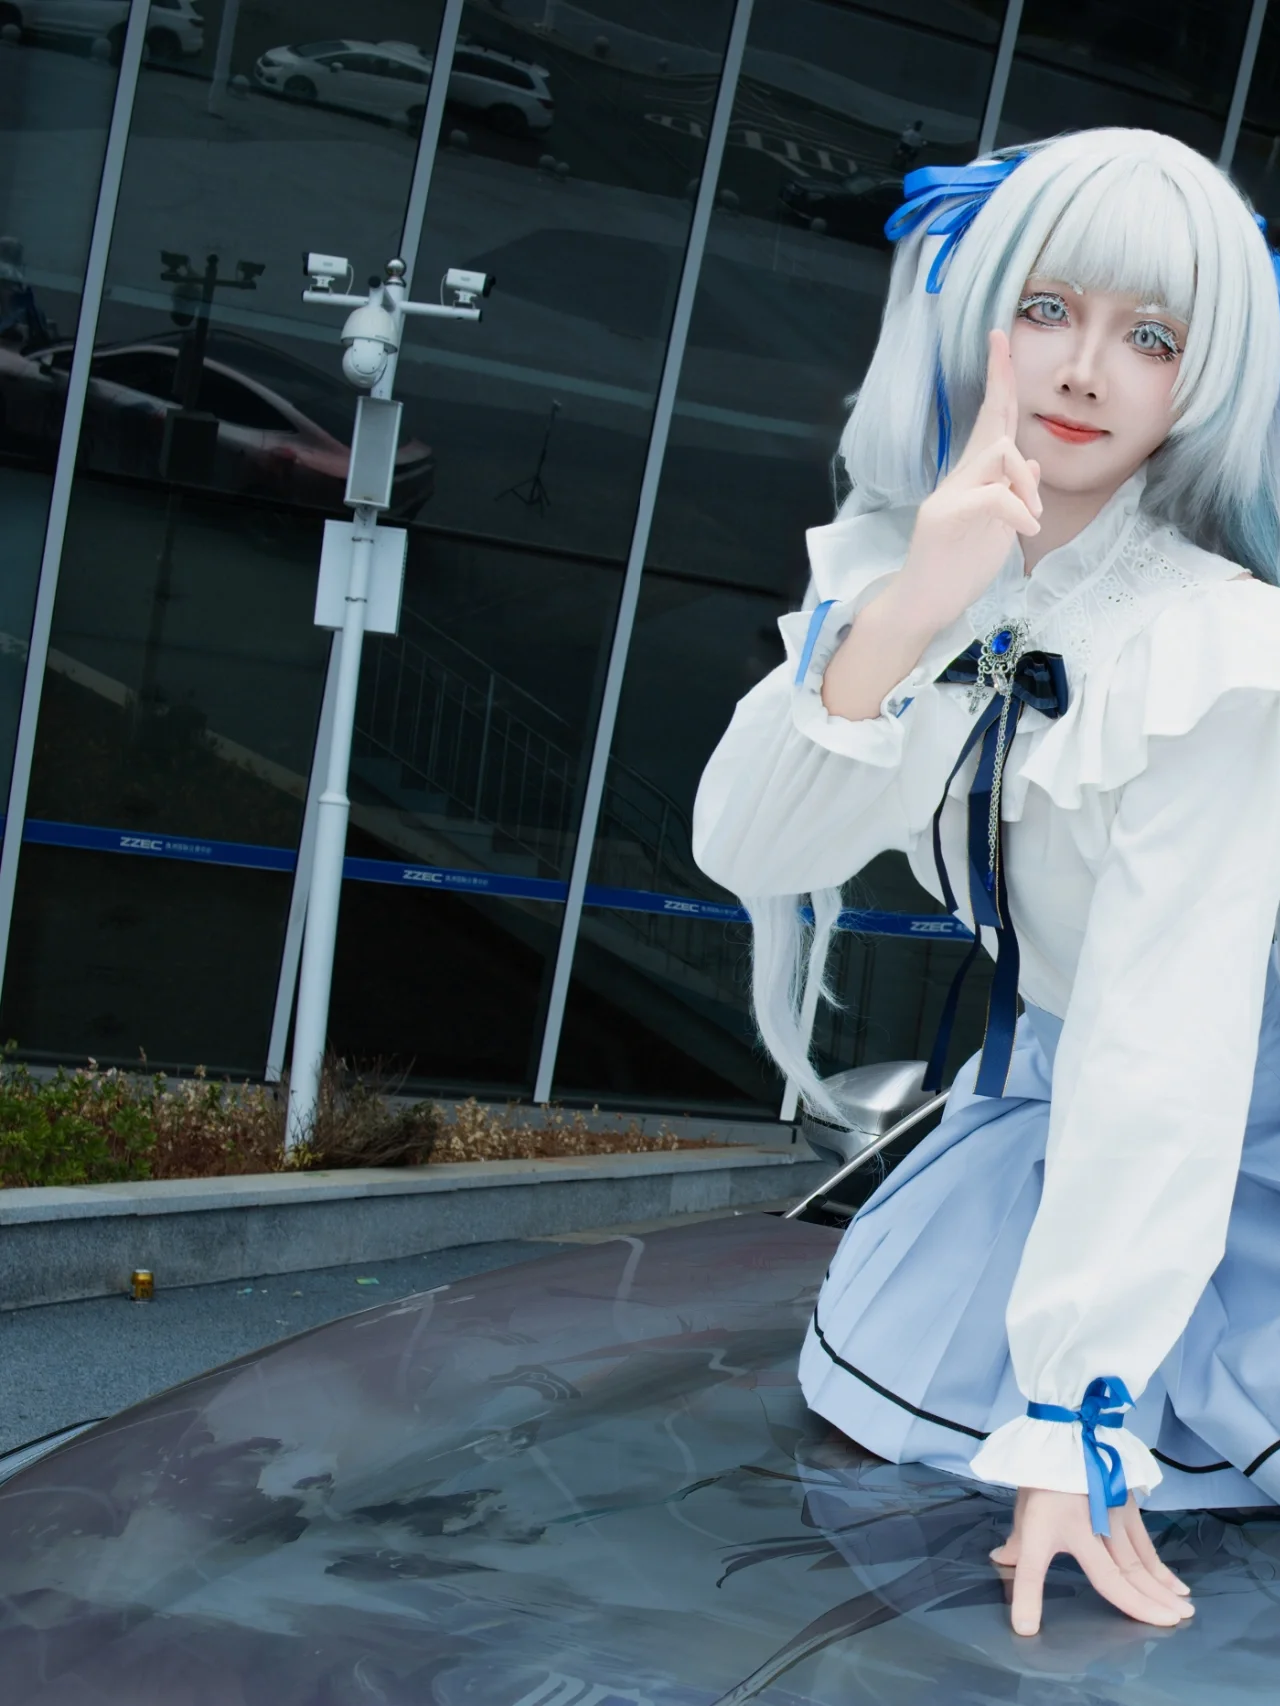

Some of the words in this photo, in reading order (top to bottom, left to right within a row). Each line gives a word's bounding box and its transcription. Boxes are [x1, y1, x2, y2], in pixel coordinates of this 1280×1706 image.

[120, 836, 163, 851] ZZEC
[402, 869, 443, 883] ZZEC
[663, 900, 699, 913] ZZEC
[910, 921, 954, 933] ZZEC
